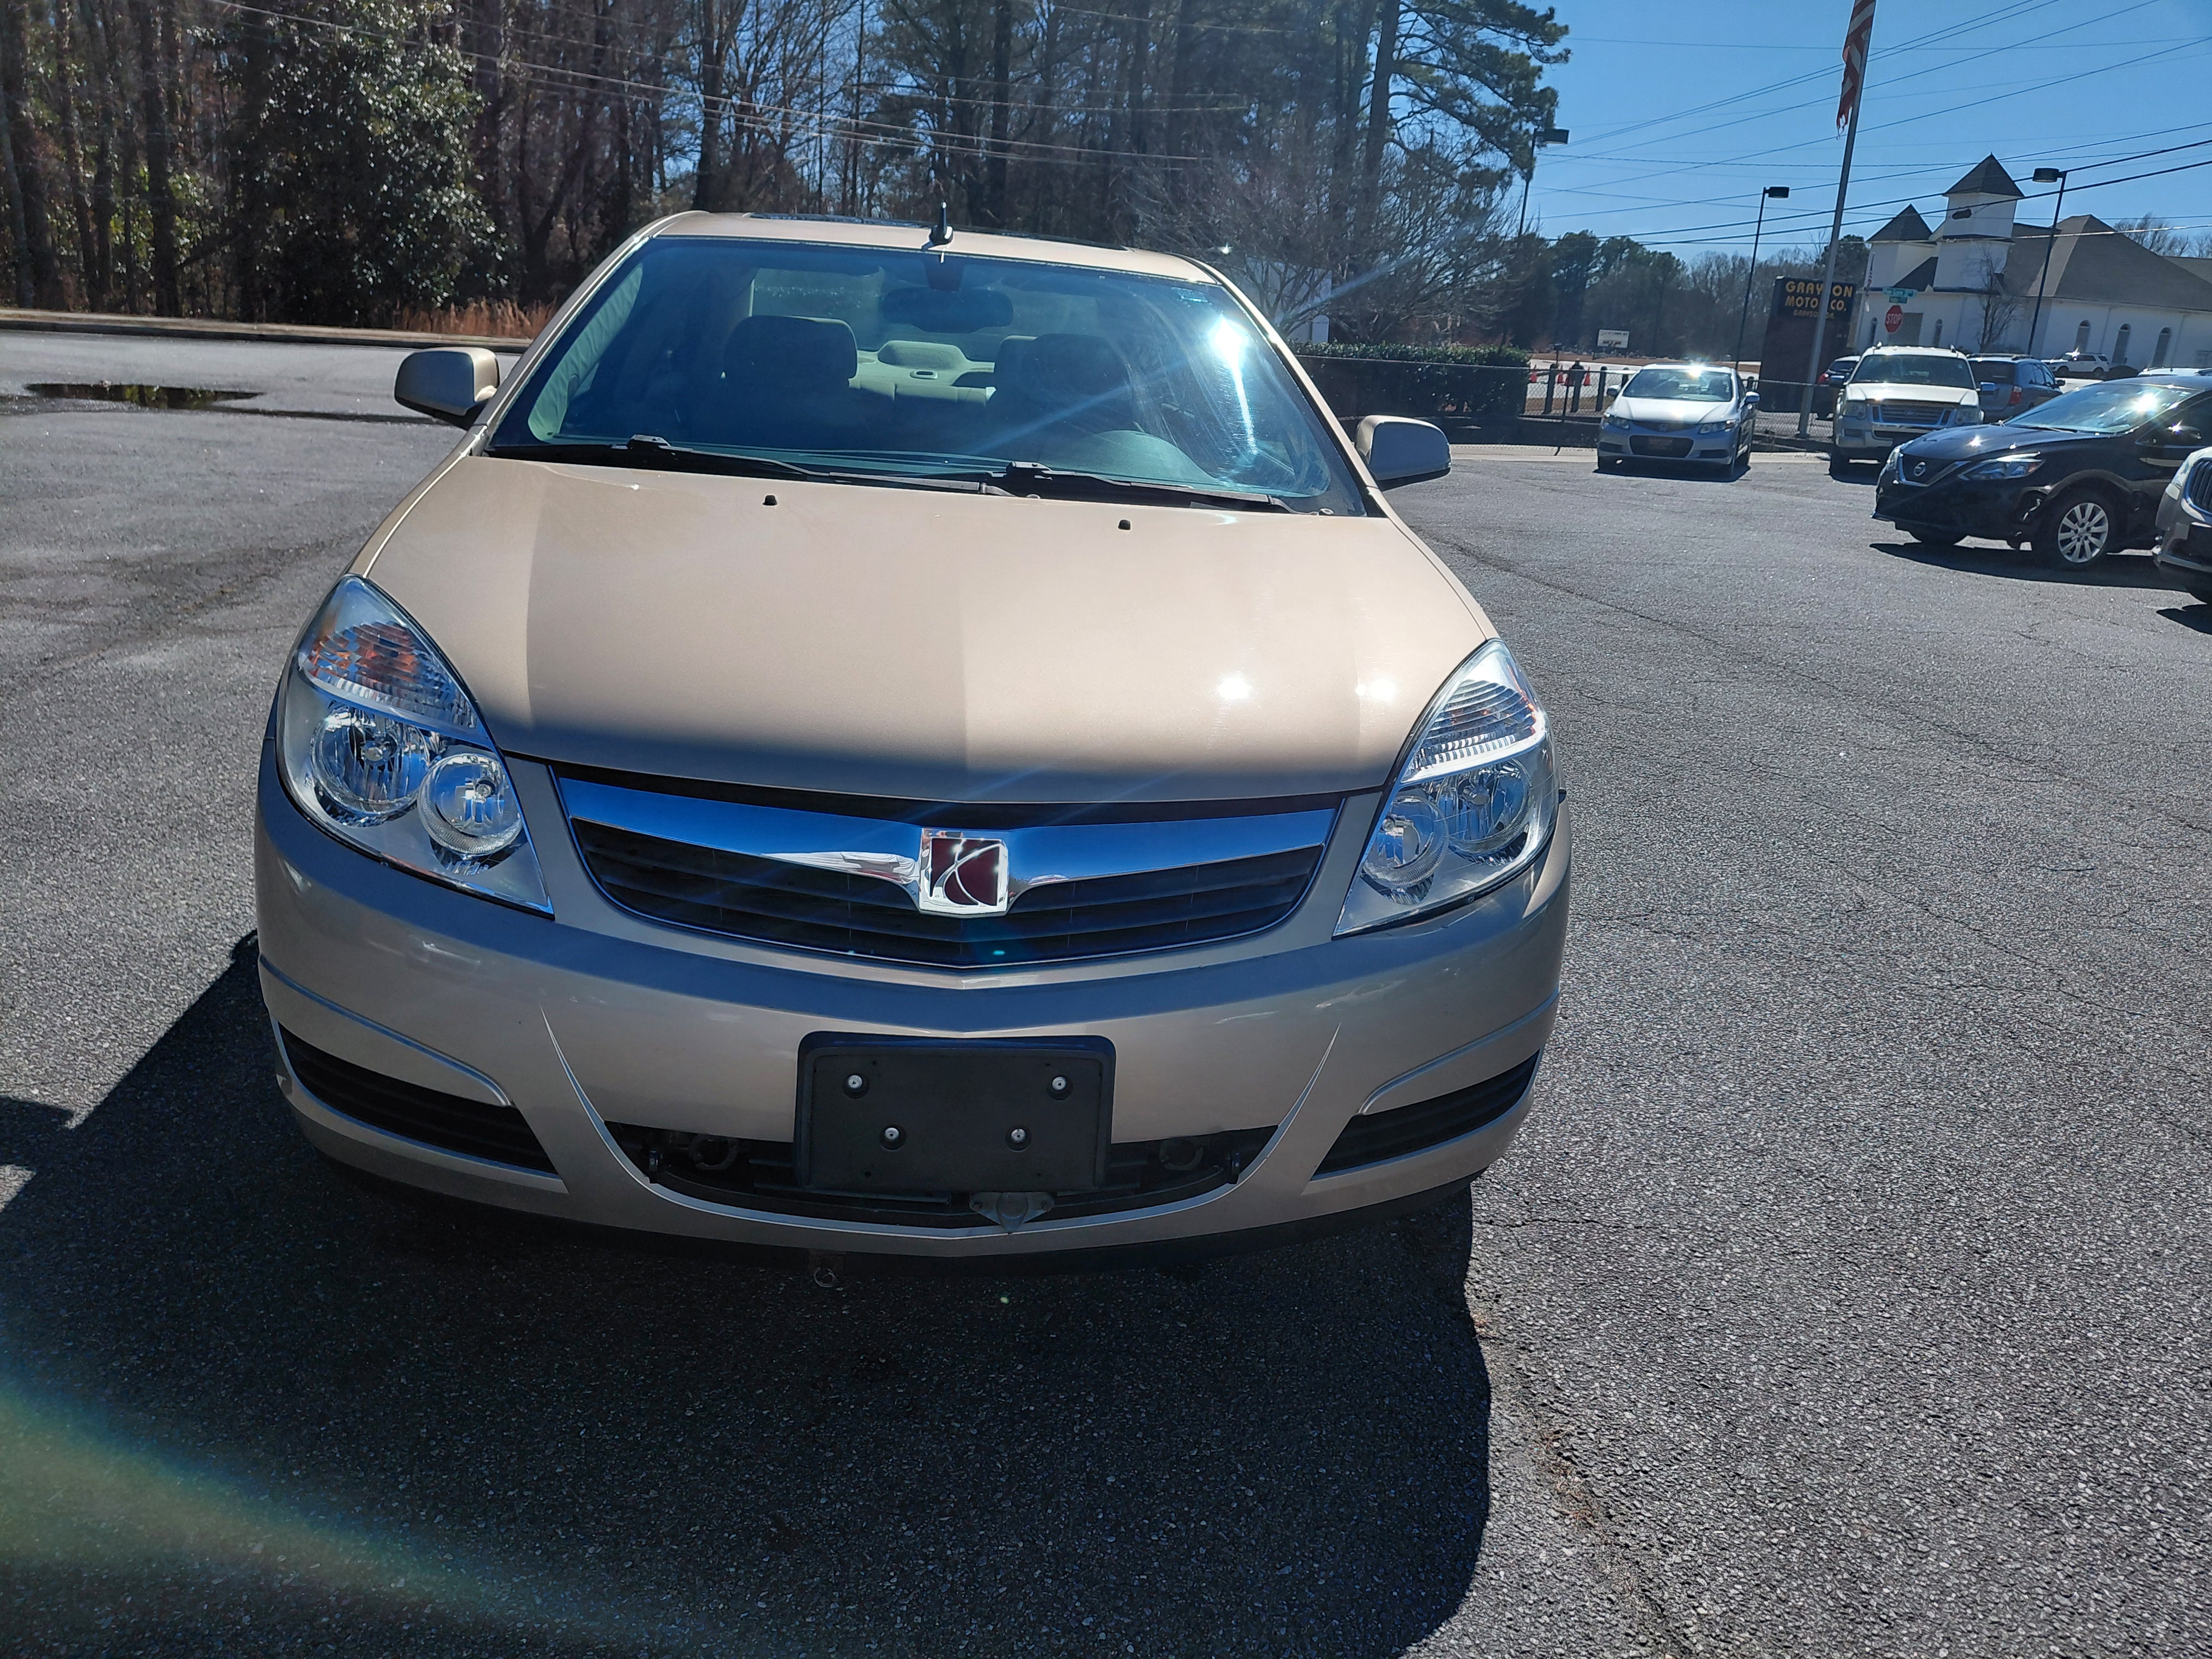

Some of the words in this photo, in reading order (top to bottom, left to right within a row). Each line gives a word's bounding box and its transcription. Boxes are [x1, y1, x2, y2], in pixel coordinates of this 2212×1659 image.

[1786, 280, 1853, 297] GRAYON
[1785, 295, 1819, 308] MOTO
[1830, 299, 1847, 311] CO.
[1886, 313, 1902, 324] STOP
